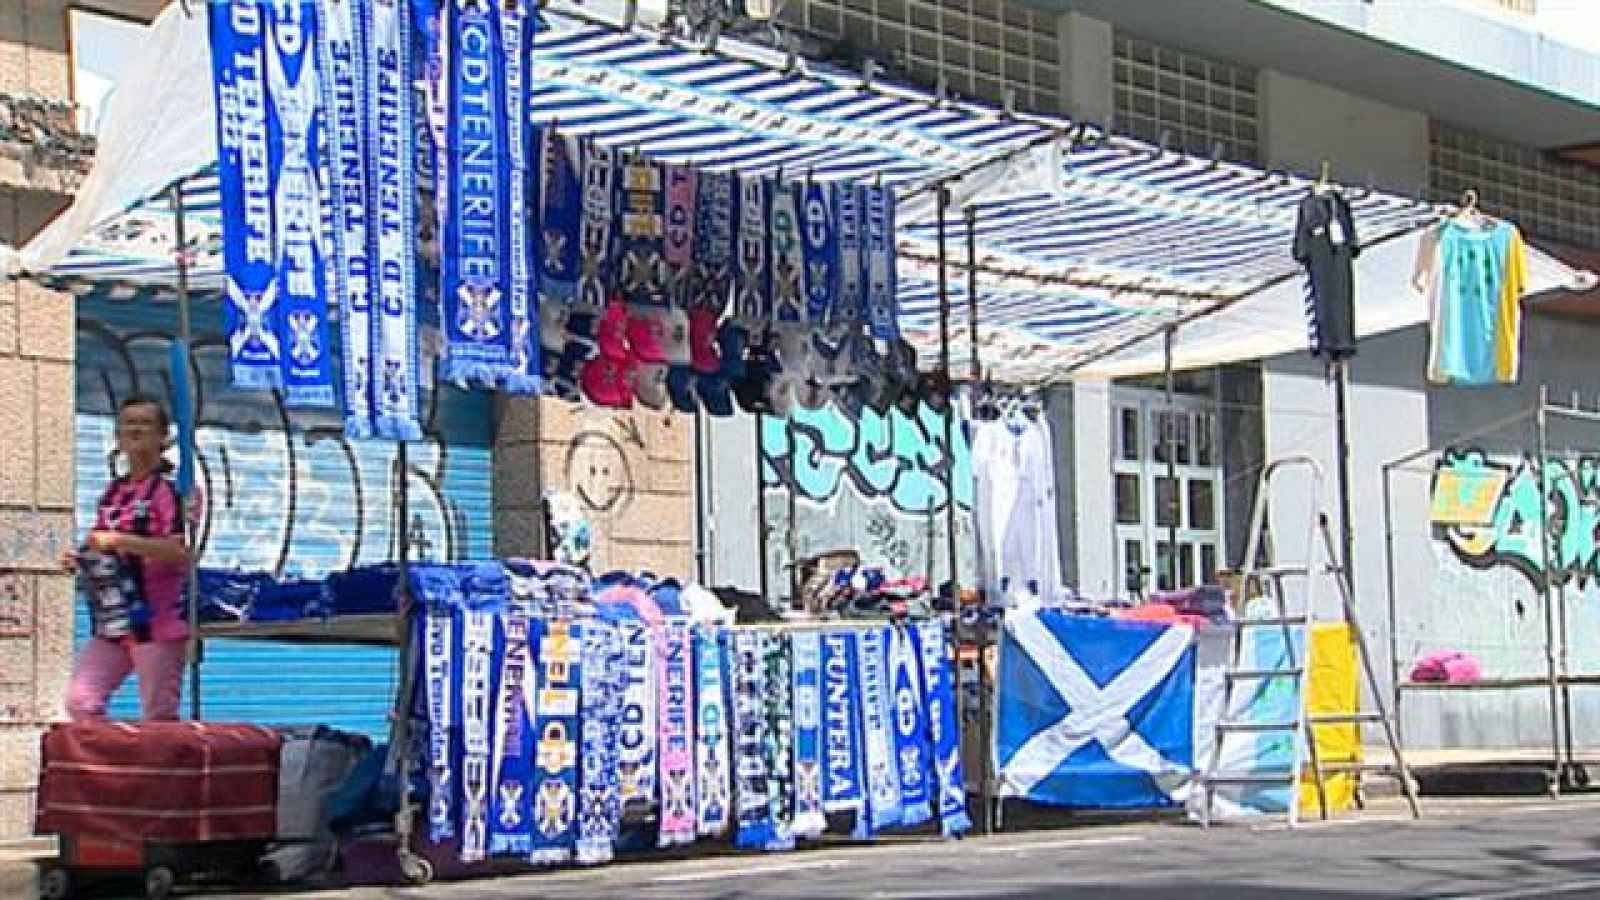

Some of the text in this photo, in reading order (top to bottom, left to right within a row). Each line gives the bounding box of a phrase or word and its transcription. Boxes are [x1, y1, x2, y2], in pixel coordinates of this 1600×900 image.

[235, 47, 272, 264] TENERIFE
[331, 39, 364, 232] TENERIFE
[379, 48, 400, 236] TENERIFE
[825, 635, 852, 796] PUNTERA
